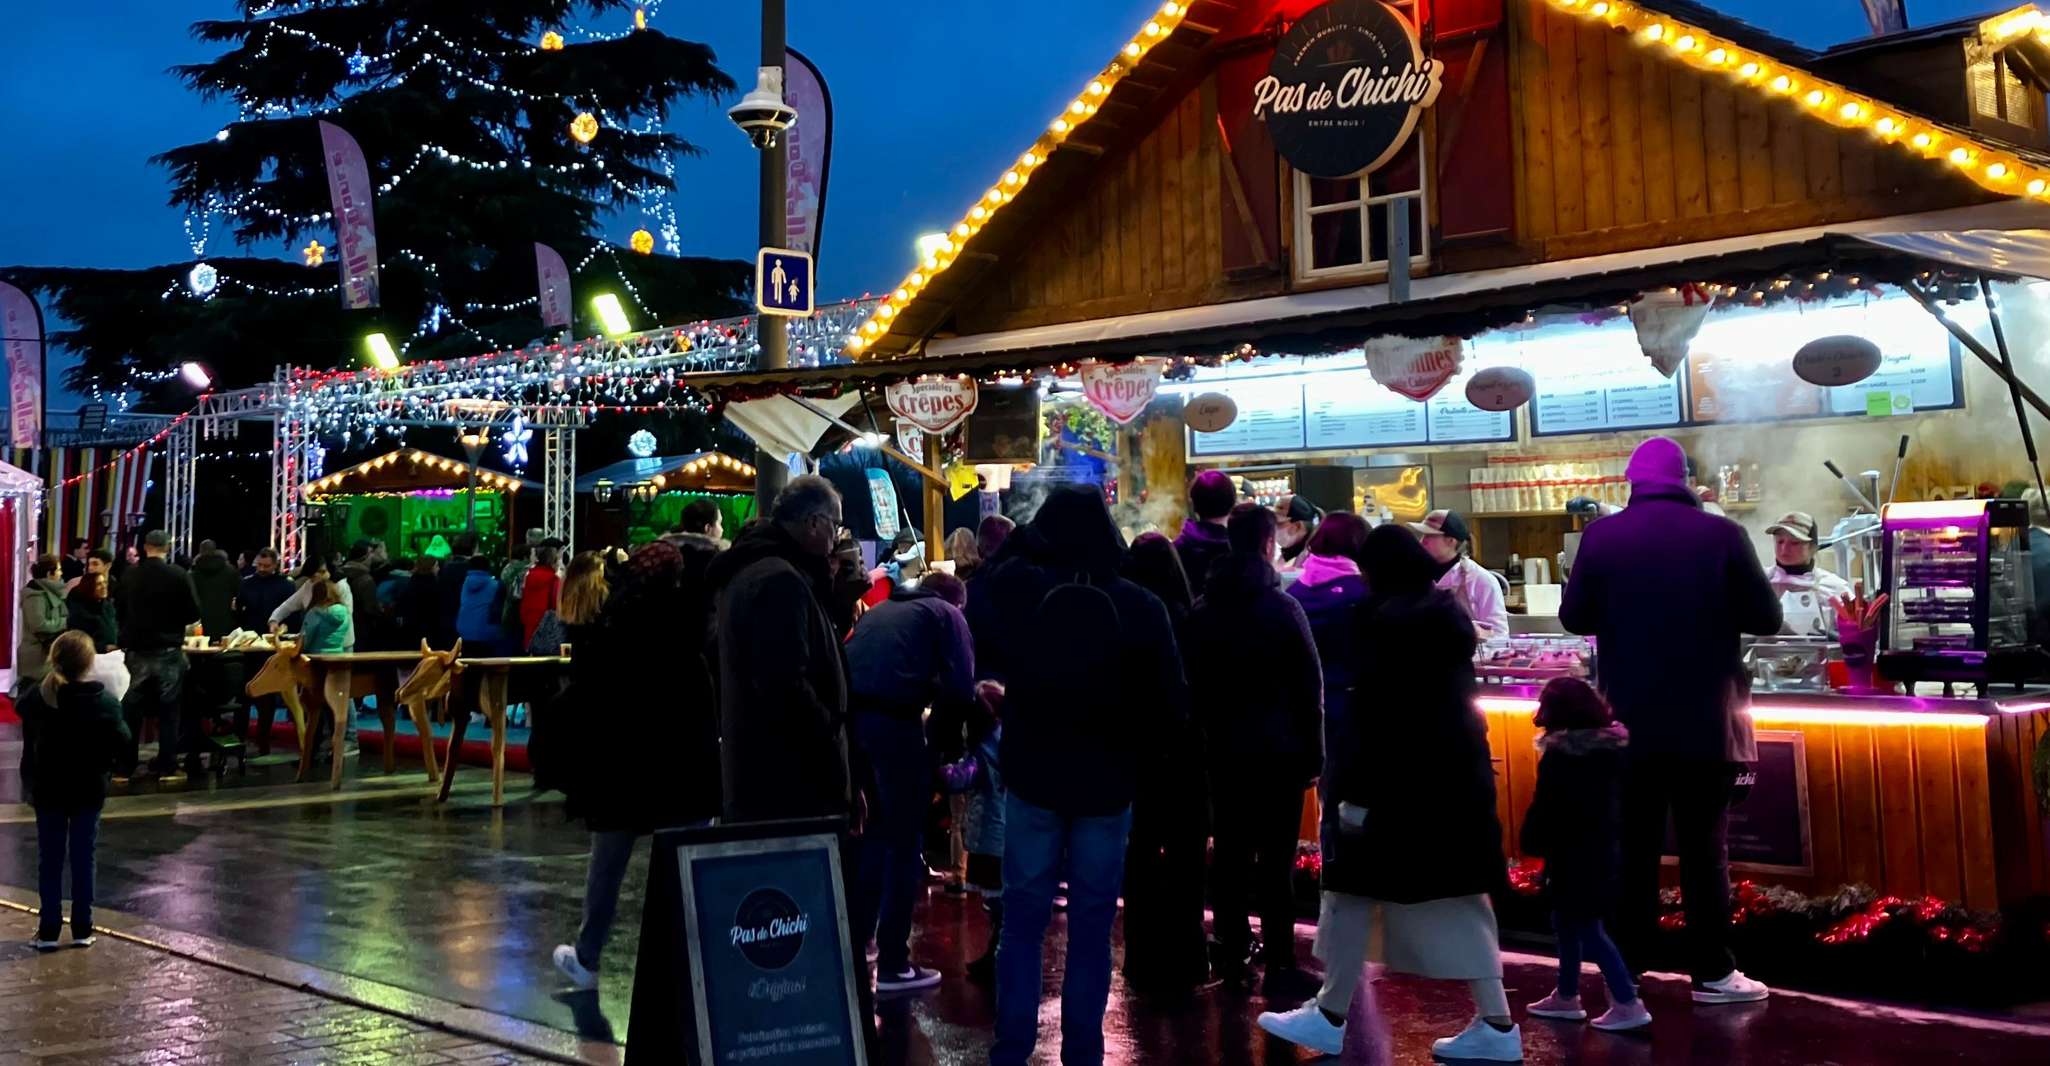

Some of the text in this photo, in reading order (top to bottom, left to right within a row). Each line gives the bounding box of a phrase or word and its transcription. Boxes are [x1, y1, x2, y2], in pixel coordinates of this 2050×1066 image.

[1317, 23, 1348, 39] QUALITY
[1253, 61, 1431, 117] Pas de Chichi
[898, 392, 964, 416] Crêpes
[1734, 772, 1757, 786] ichi
[730, 913, 809, 946] Pas de Chichi
